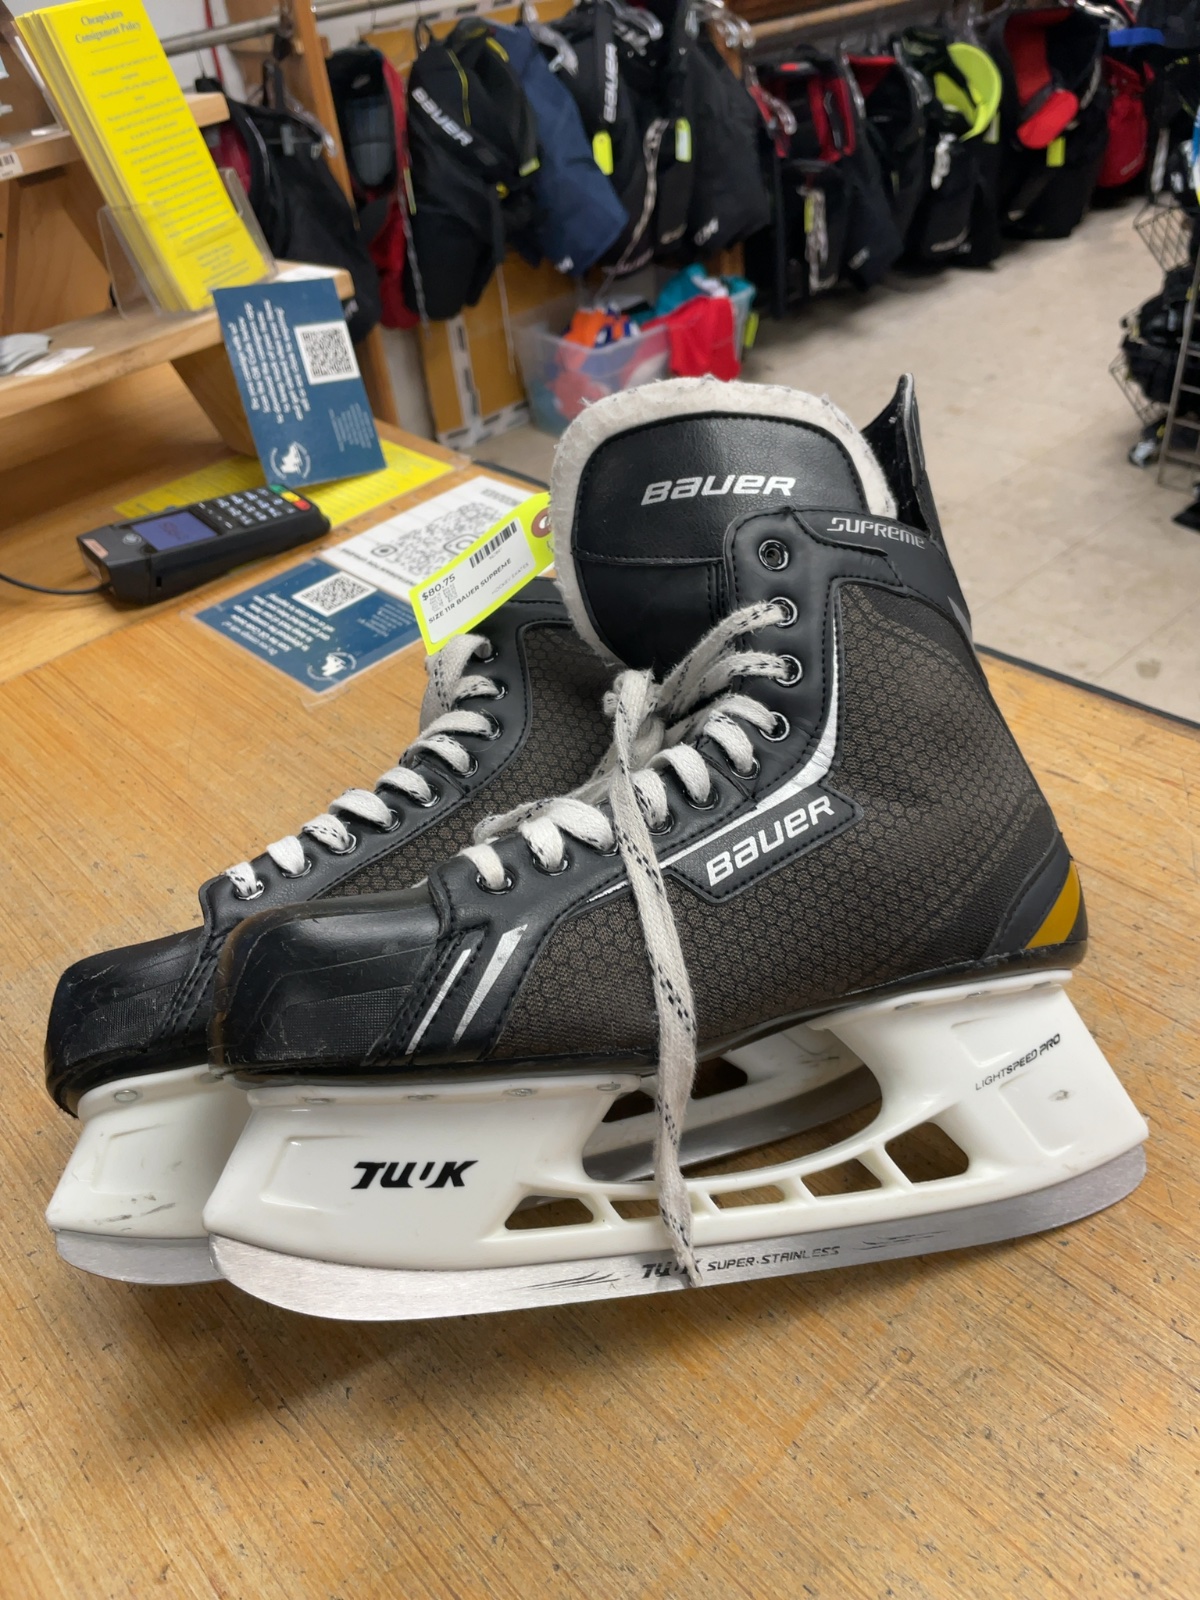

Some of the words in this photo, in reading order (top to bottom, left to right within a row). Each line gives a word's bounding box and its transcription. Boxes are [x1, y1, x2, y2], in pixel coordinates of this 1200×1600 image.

[411, 86, 474, 147] BAUER
[641, 474, 796, 506] BAUER
[827, 517, 926, 550] SUPREME
[422, 574, 456, 601] $80.75
[428, 611, 445, 624] SIZE
[456, 584, 480, 606] BAUER
[480, 558, 512, 587] SUPREME
[706, 795, 835, 887] BAUER
[975, 1049, 1038, 1091] LIGHTSPEED
[1039, 1033, 1061, 1055] PRO
